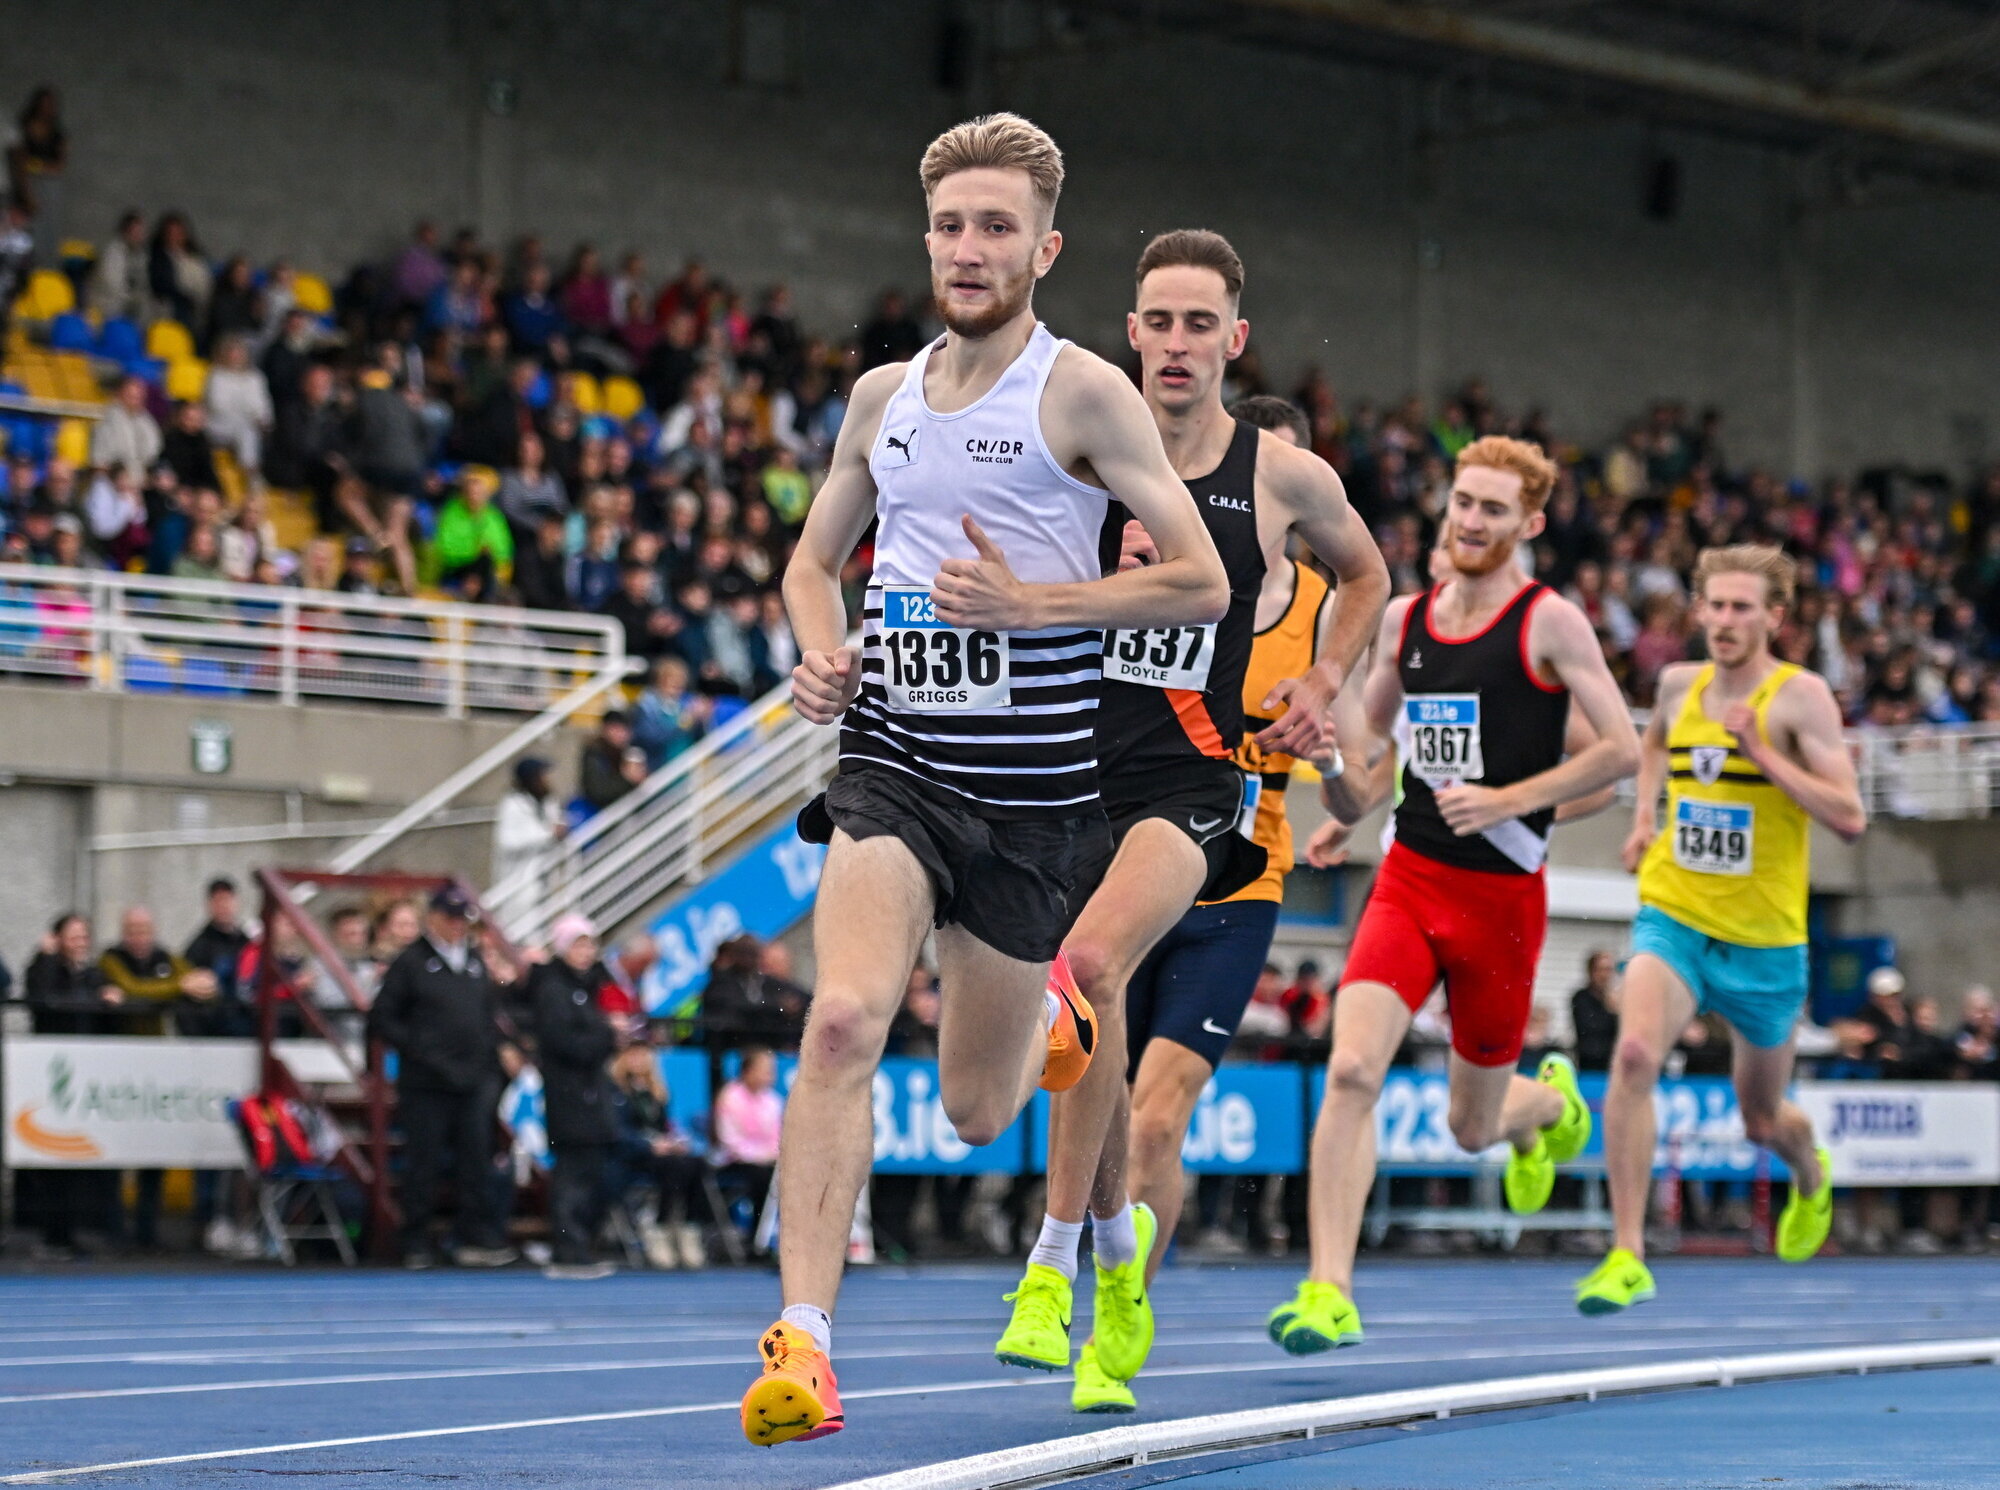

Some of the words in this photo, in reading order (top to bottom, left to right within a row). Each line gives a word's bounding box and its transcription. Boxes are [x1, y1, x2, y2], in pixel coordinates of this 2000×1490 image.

[966, 439, 1024, 455] CN/DR
[972, 455, 993, 464] TRACK
[1209, 494, 1252, 513] C.H.A.C.
[1104, 626, 1205, 671] 1337
[885, 630, 1001, 688] 1336
[1121, 663, 1168, 681] DOYLE
[908, 690, 968, 703] GRIGGS
[1415, 726, 1472, 763] 1367
[1679, 826, 1746, 863] 1349
